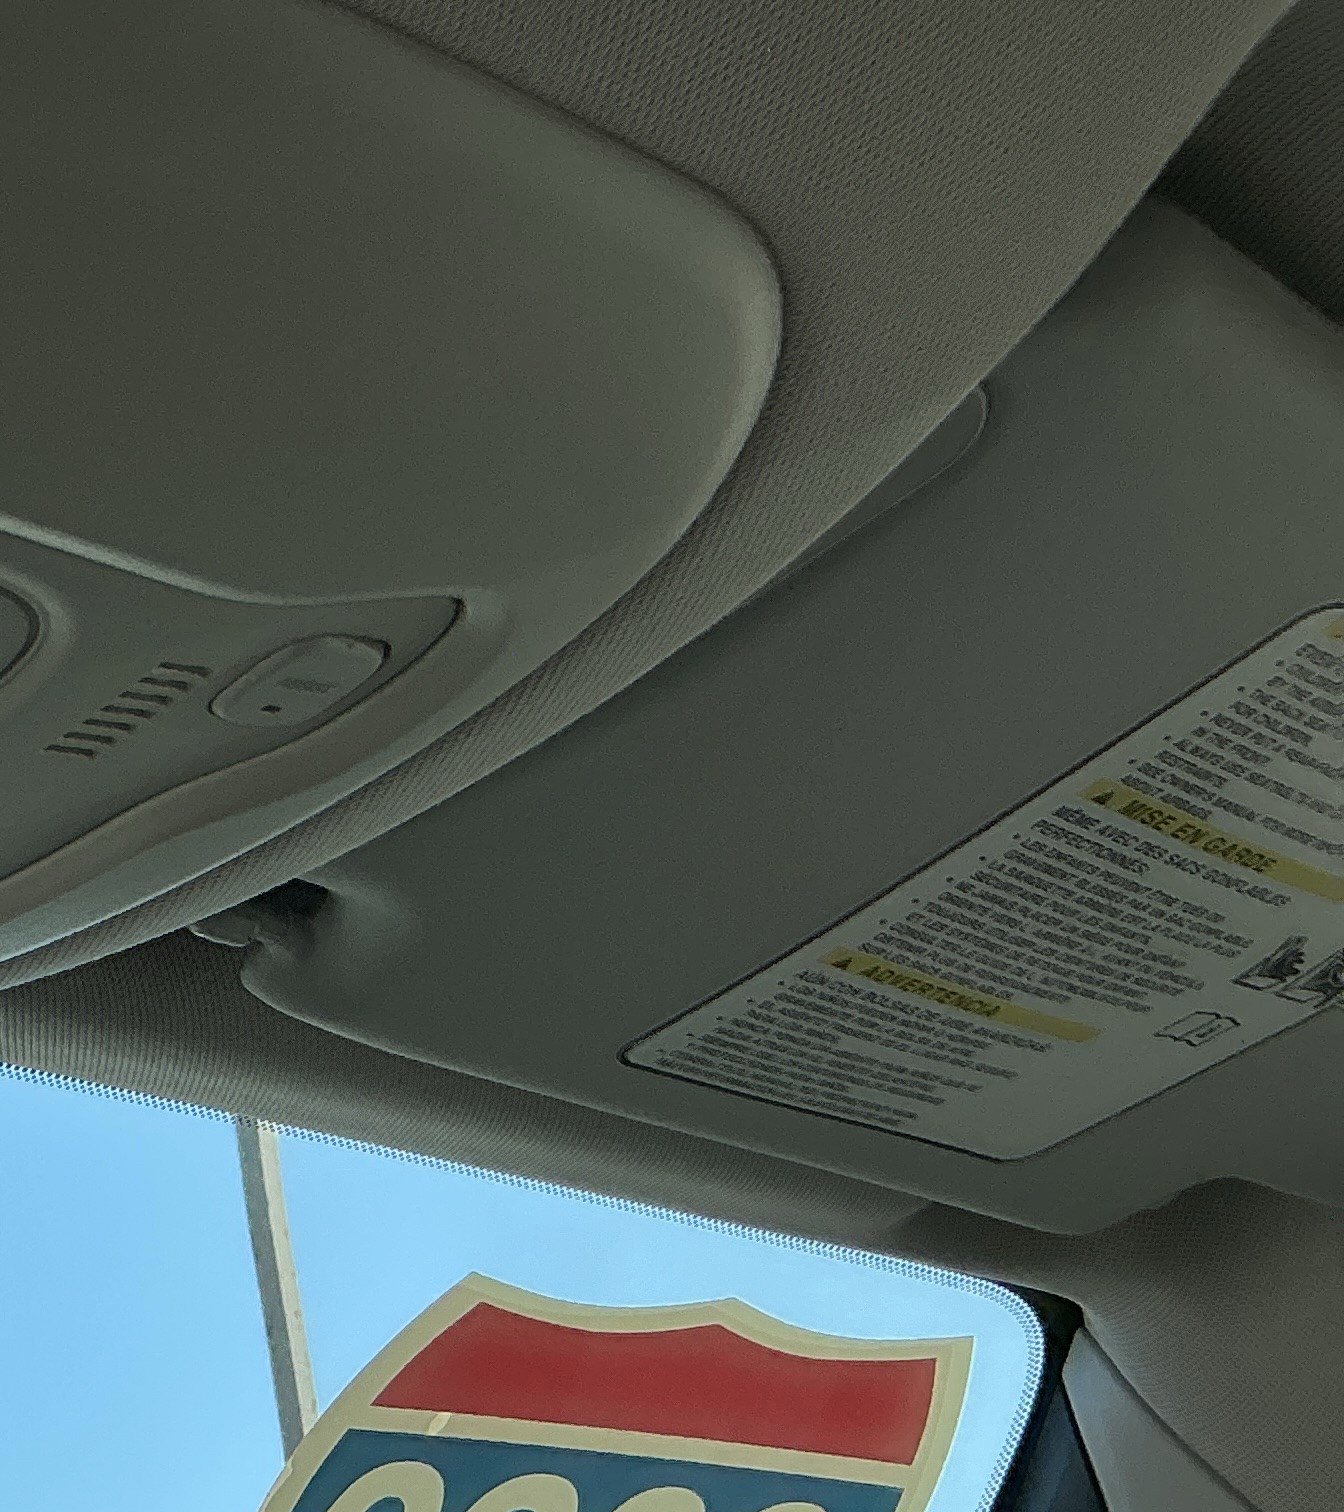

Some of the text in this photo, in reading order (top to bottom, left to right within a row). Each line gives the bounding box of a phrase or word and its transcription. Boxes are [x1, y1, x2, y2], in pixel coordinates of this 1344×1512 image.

[1118, 800, 1176, 831] MISE
[1170, 824, 1206, 844] EN
[1202, 838, 1276, 872] GARDE
